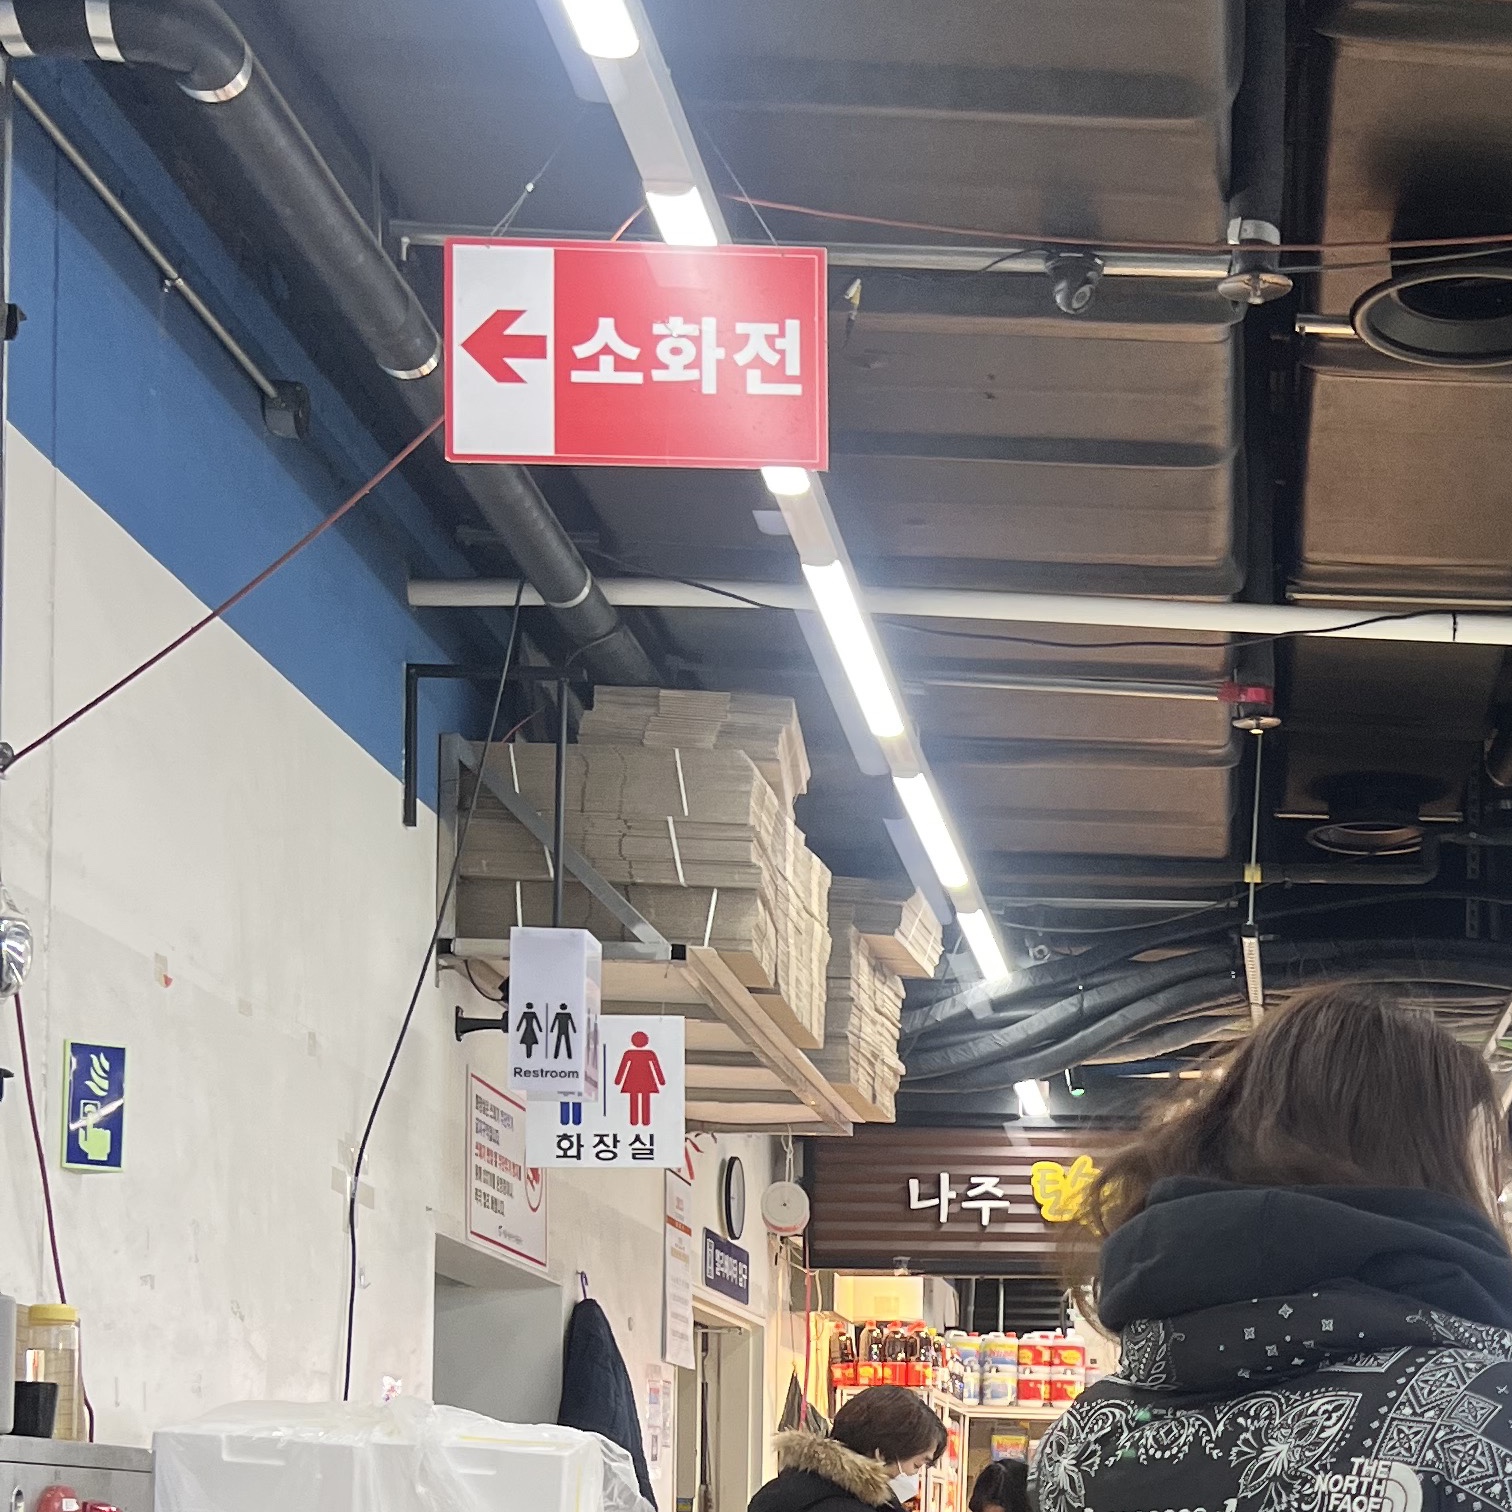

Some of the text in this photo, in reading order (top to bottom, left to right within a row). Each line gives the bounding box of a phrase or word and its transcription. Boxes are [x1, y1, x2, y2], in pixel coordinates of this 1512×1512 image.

[570, 316, 803, 396] 소화전
[513, 1066, 580, 1080] Restroom
[555, 1132, 656, 1161] 화장실
[908, 1171, 1011, 1227] 나주
[1350, 1456, 1393, 1479] THE
[1313, 1471, 1389, 1498] NORTH
